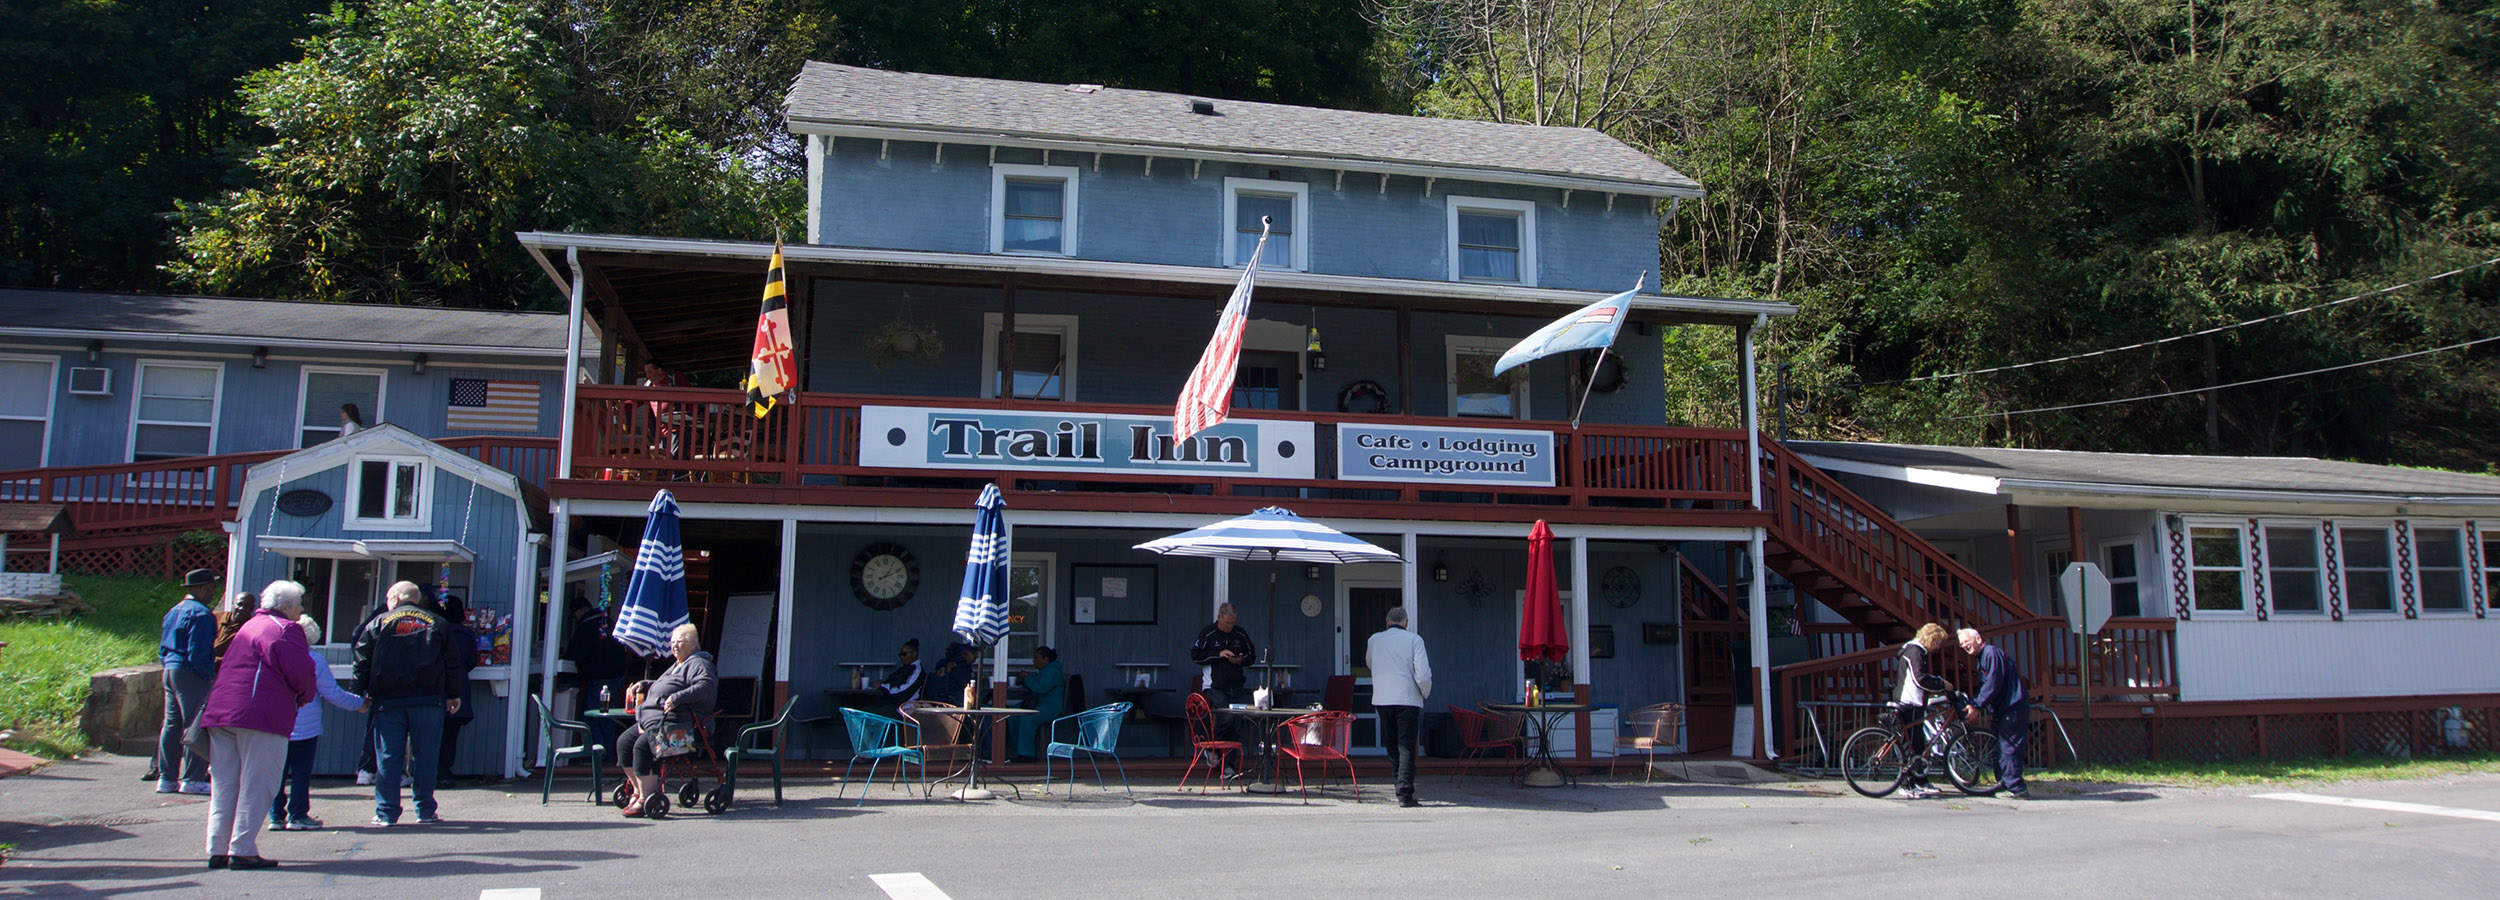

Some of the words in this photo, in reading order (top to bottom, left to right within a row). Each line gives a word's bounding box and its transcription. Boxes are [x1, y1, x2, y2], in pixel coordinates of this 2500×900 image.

[931, 418, 1104, 463] Trail
[1129, 424, 1251, 467] Inn
[1357, 434, 1412, 449] Cafe
[1439, 437, 1537, 457] Lodging
[1369, 454, 1526, 475] Campground
